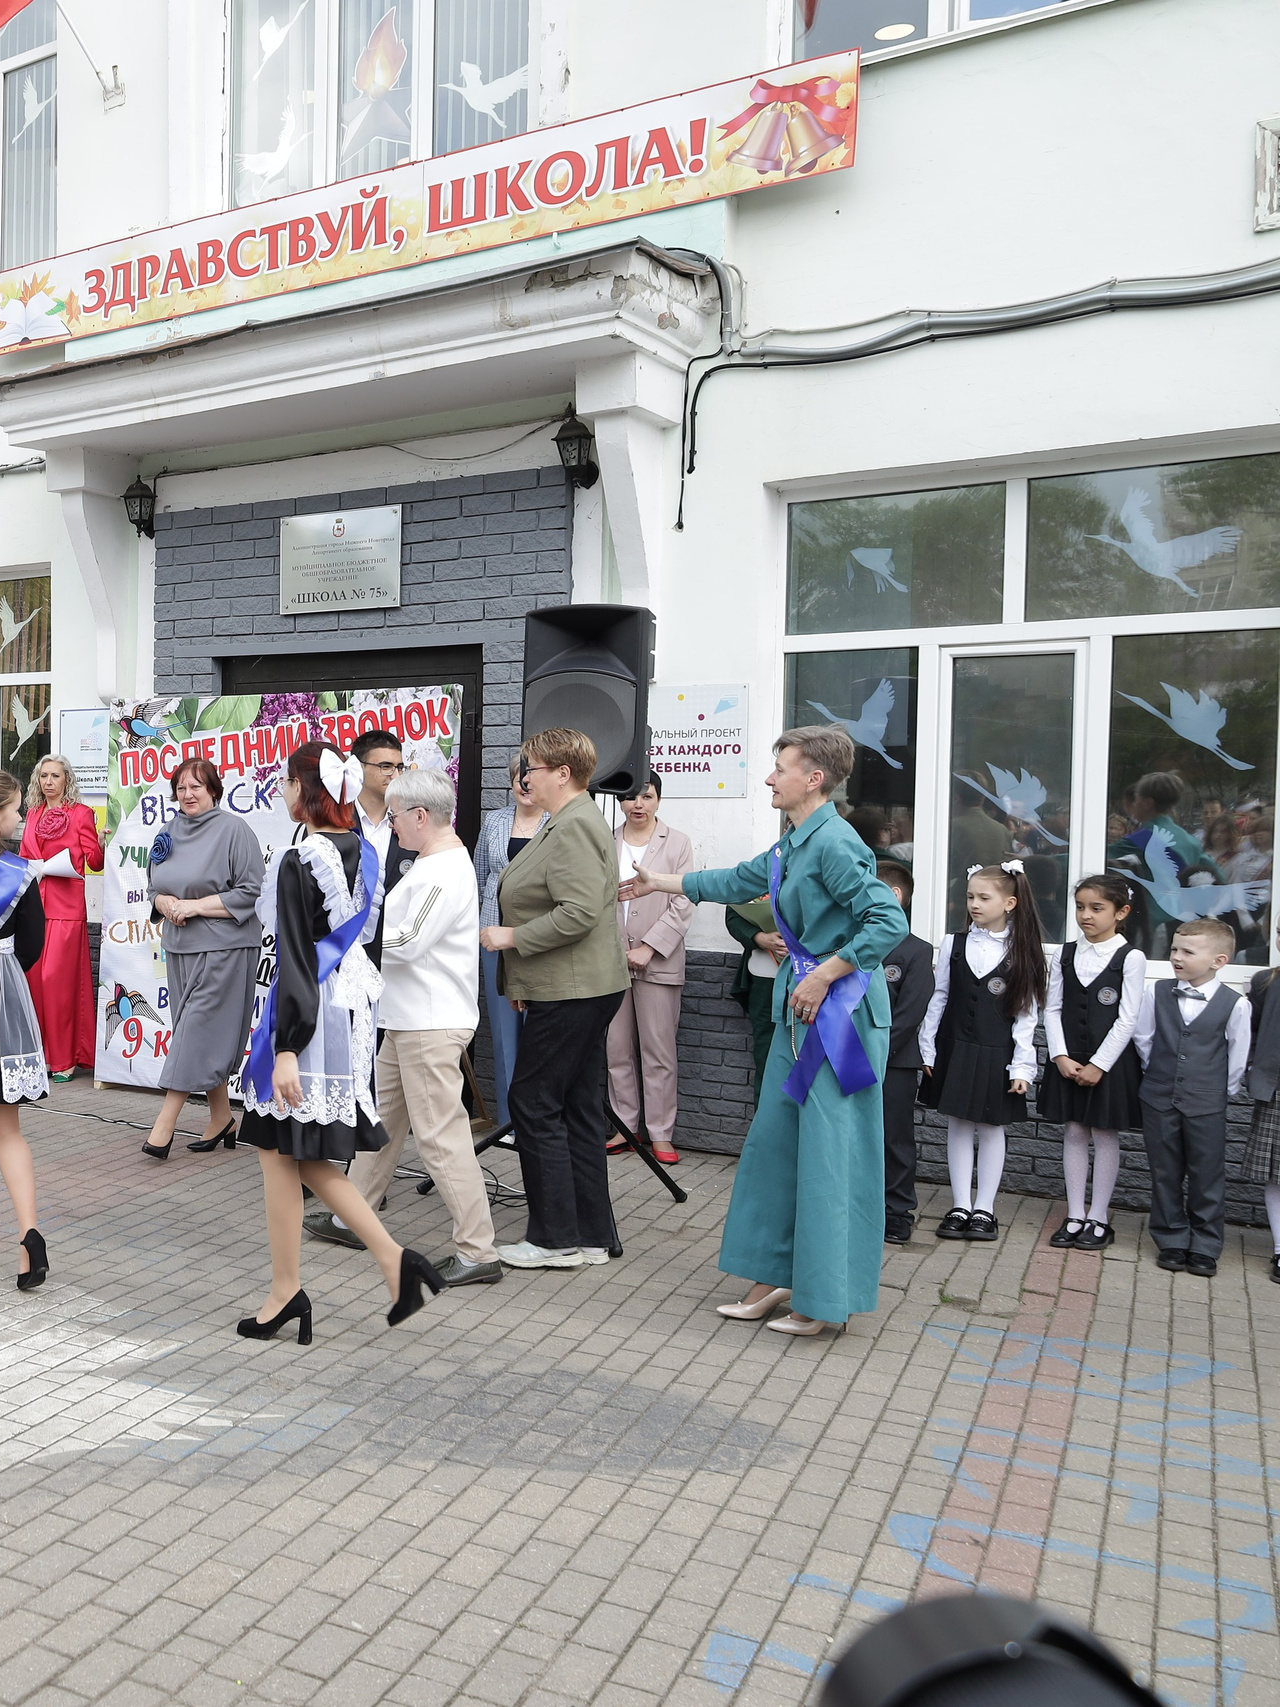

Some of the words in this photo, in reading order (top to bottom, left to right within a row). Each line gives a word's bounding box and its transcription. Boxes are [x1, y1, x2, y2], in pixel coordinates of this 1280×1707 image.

[82, 187, 405, 319] ЗДРАВСТВУЙ,
[427, 118, 707, 233] ШКОЛА!
[291, 590, 347, 604] «ШКОЛА
[351, 588, 366, 600] №
[369, 587, 388, 599] 75»
[321, 697, 451, 752] ЗВОНОК
[652, 728, 698, 738] АЛЬНЫЙ
[700, 728, 742, 738] ПРОЕКТ
[668, 744, 741, 757] КАЖДОГО
[122, 1018, 144, 1059] 9
